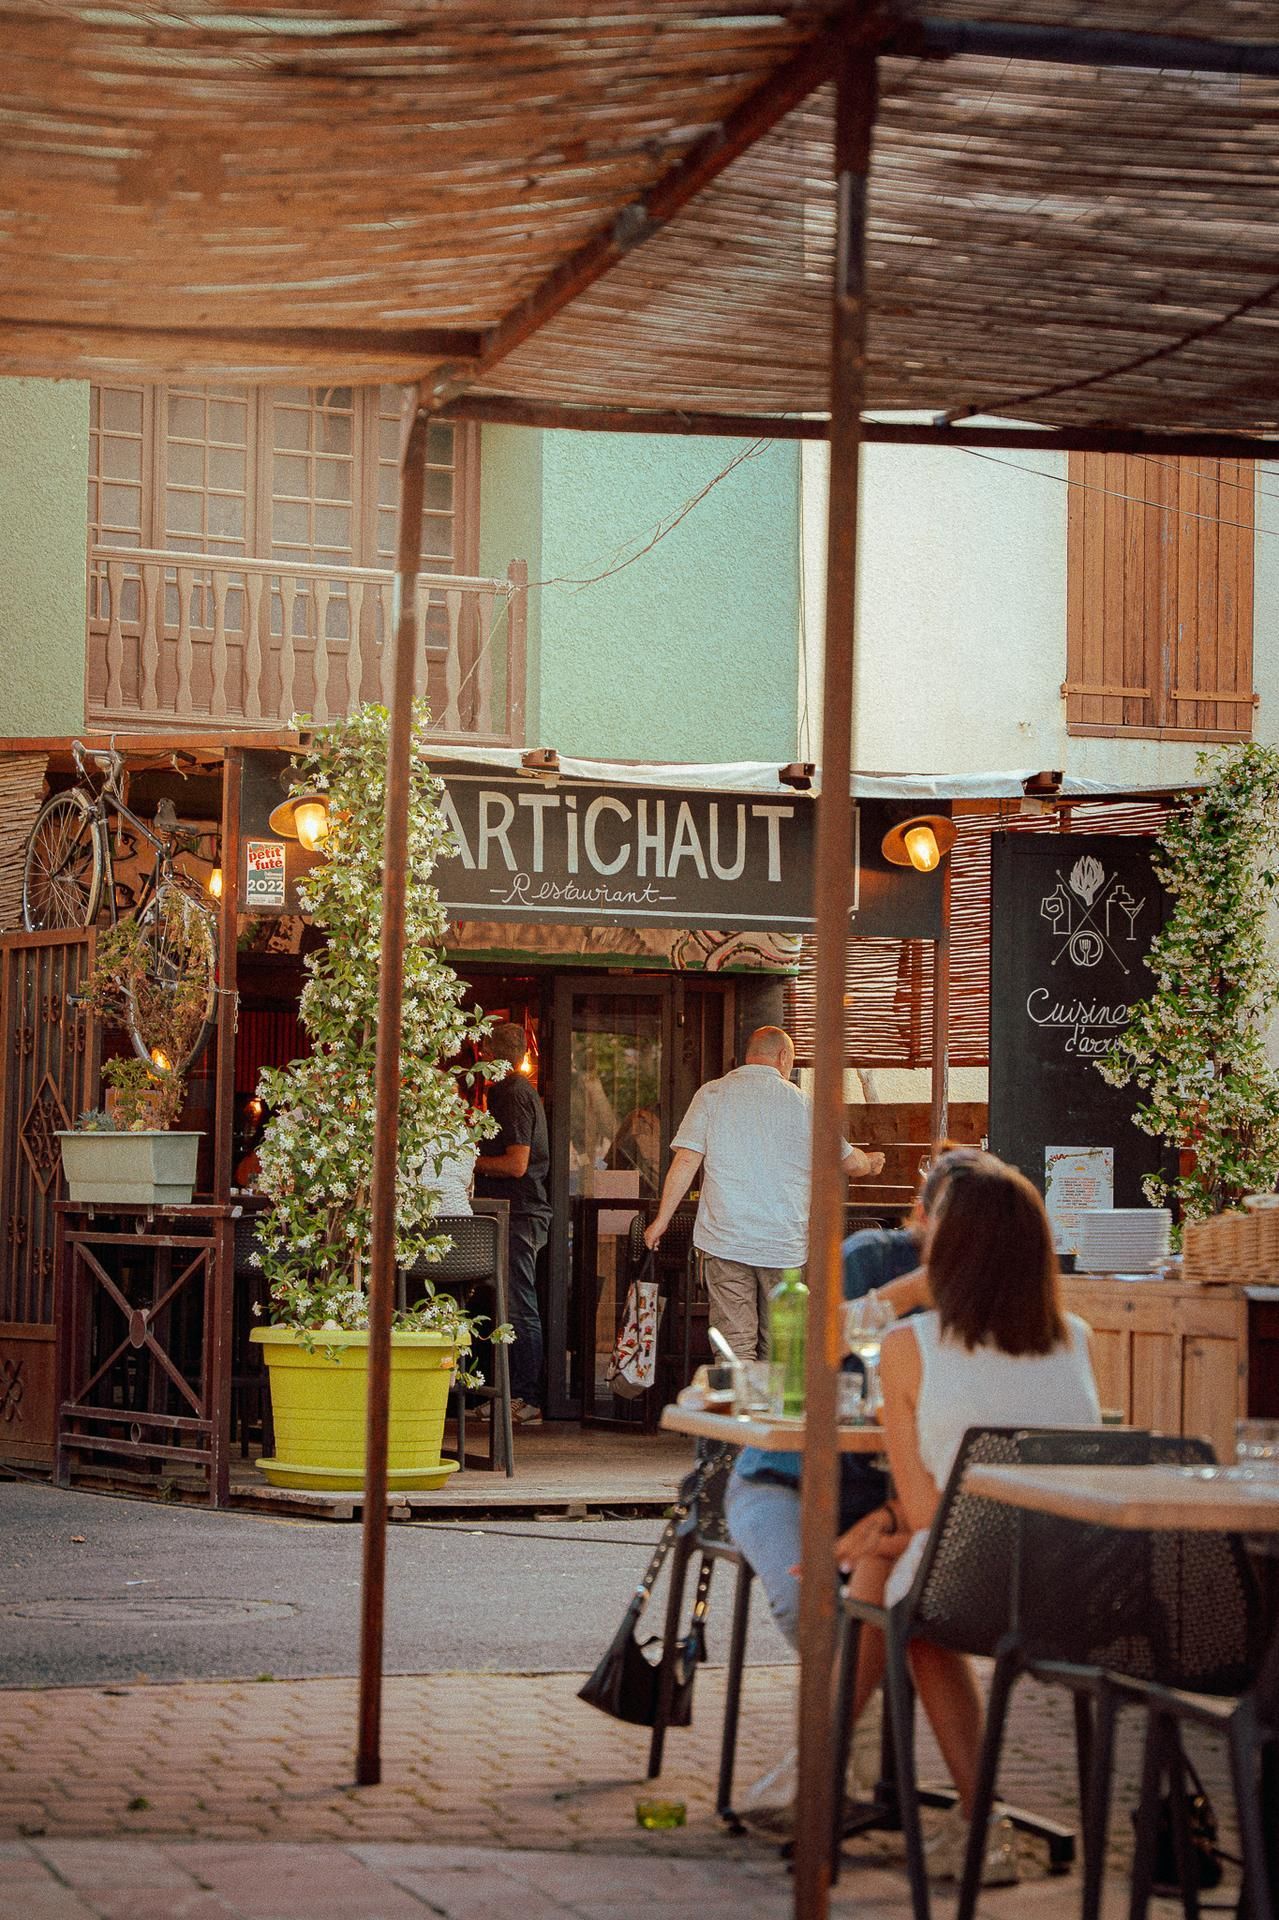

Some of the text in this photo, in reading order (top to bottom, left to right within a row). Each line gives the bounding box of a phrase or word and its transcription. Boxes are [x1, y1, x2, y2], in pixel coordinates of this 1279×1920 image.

[248, 847, 281, 863] petit
[248, 880, 284, 892] 2022
[1027, 988, 1130, 1024] Cuisine
